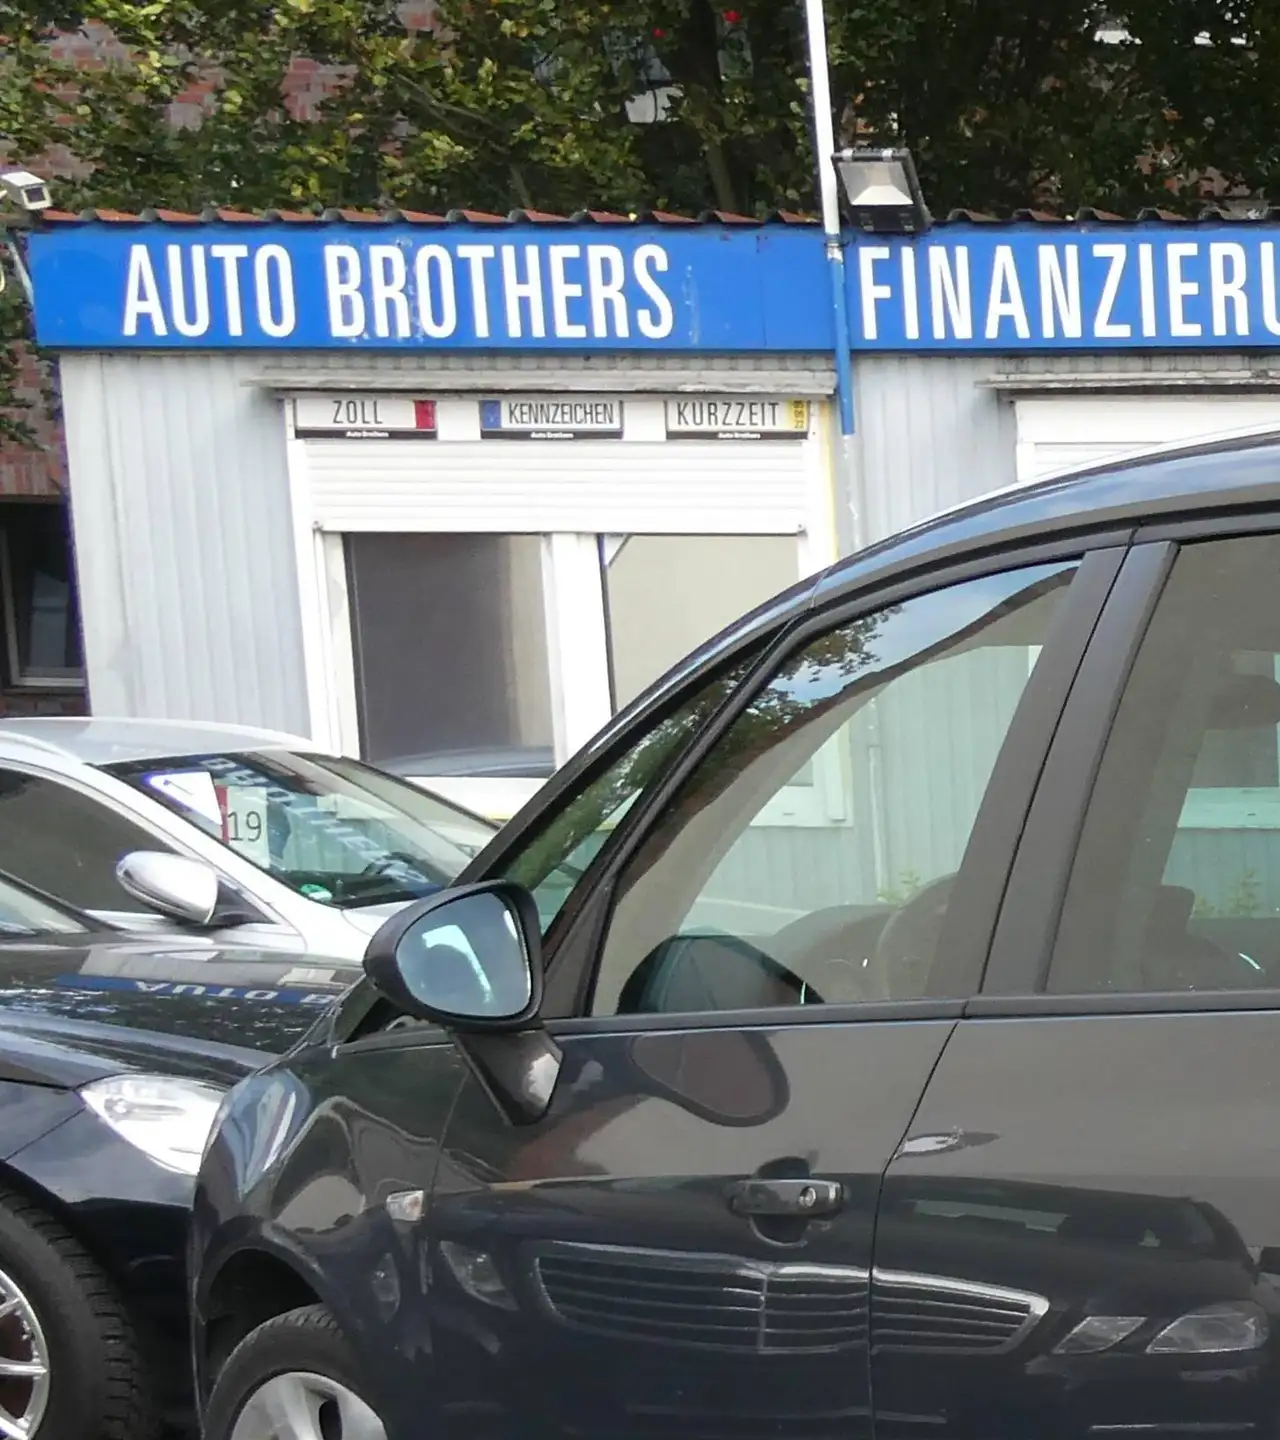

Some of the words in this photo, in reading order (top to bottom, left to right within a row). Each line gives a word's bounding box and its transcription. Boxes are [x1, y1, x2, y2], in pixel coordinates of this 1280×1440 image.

[123, 244, 296, 337] AUTO
[326, 244, 675, 340] BROTHERS
[332, 400, 383, 424] ZOLL
[508, 402, 614, 424] KENNZEICHEN
[677, 402, 779, 426] KURZZEIT
[227, 811, 262, 843] 19
